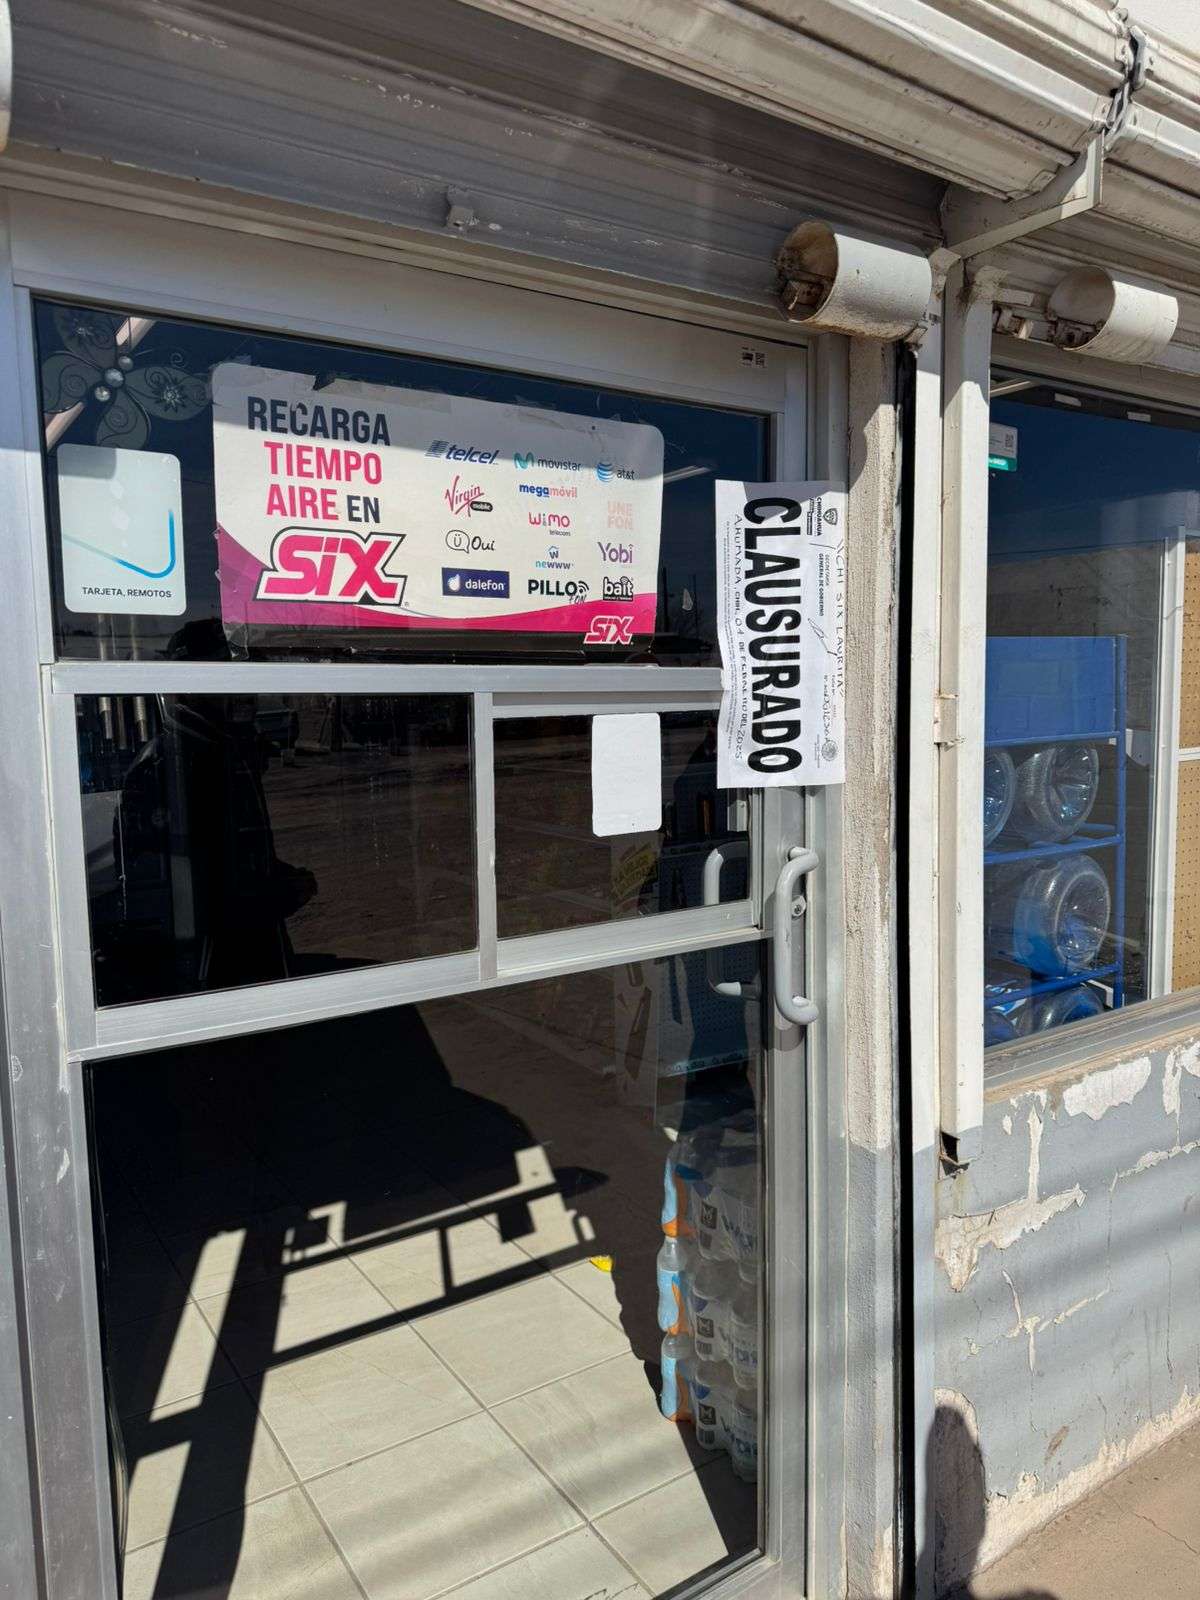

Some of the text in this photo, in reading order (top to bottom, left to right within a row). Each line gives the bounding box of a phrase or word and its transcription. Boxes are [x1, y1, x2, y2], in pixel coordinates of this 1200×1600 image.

[247, 396, 391, 446] RECARGA
[446, 444, 499, 464] telcel
[264, 441, 383, 485] TIEMPO
[537, 457, 581, 471] movistar
[616, 467, 635, 481] at&t
[444, 475, 485, 517] Virgin
[519, 483, 578, 498] megamóvil
[266, 484, 381, 524] AIRE EN
[607, 500, 633, 515] UNE
[607, 515, 634, 530] FON
[465, 578, 505, 591] dalefon
[603, 576, 634, 597] bait
[82, 587, 172, 598] TARJETA, REMOTOS
[744, 498, 802, 773] CLAUSURADO
[739, 642, 744, 652] DE
